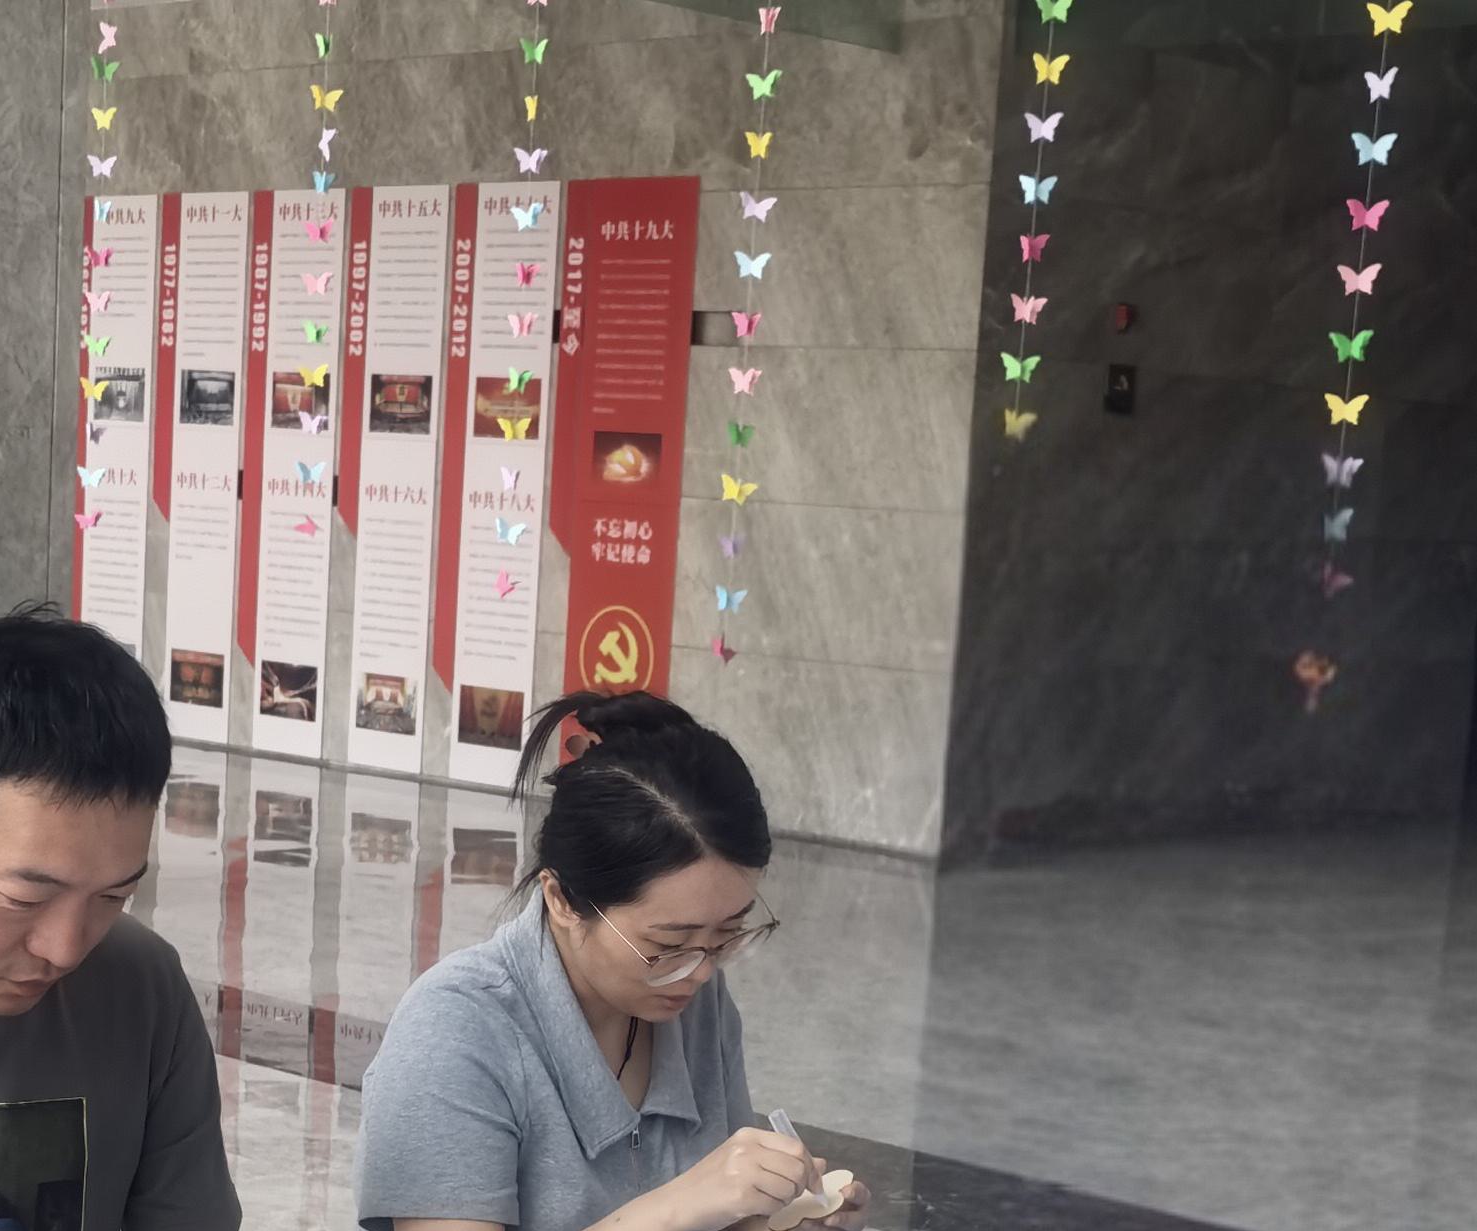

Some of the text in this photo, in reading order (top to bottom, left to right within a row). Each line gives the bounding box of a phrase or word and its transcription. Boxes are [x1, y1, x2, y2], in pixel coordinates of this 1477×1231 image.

[185, 203, 242, 225] 中共十一大
[279, 201, 338, 223] 中共十三大
[377, 198, 442, 219] 中共十五大
[483, 194, 552, 217] 中共十大
[600, 219, 674, 241] 中共十九大
[348, 240, 368, 357] 1997-2002
[451, 238, 471, 358] 2007-2012
[177, 471, 232, 493] 中共十二大
[365, 484, 427, 505] 中共十六大
[469, 490, 535, 513] 中共十八大
[593, 518, 653, 541] 不忘初心
[591, 542, 652, 566] 牢记使命
